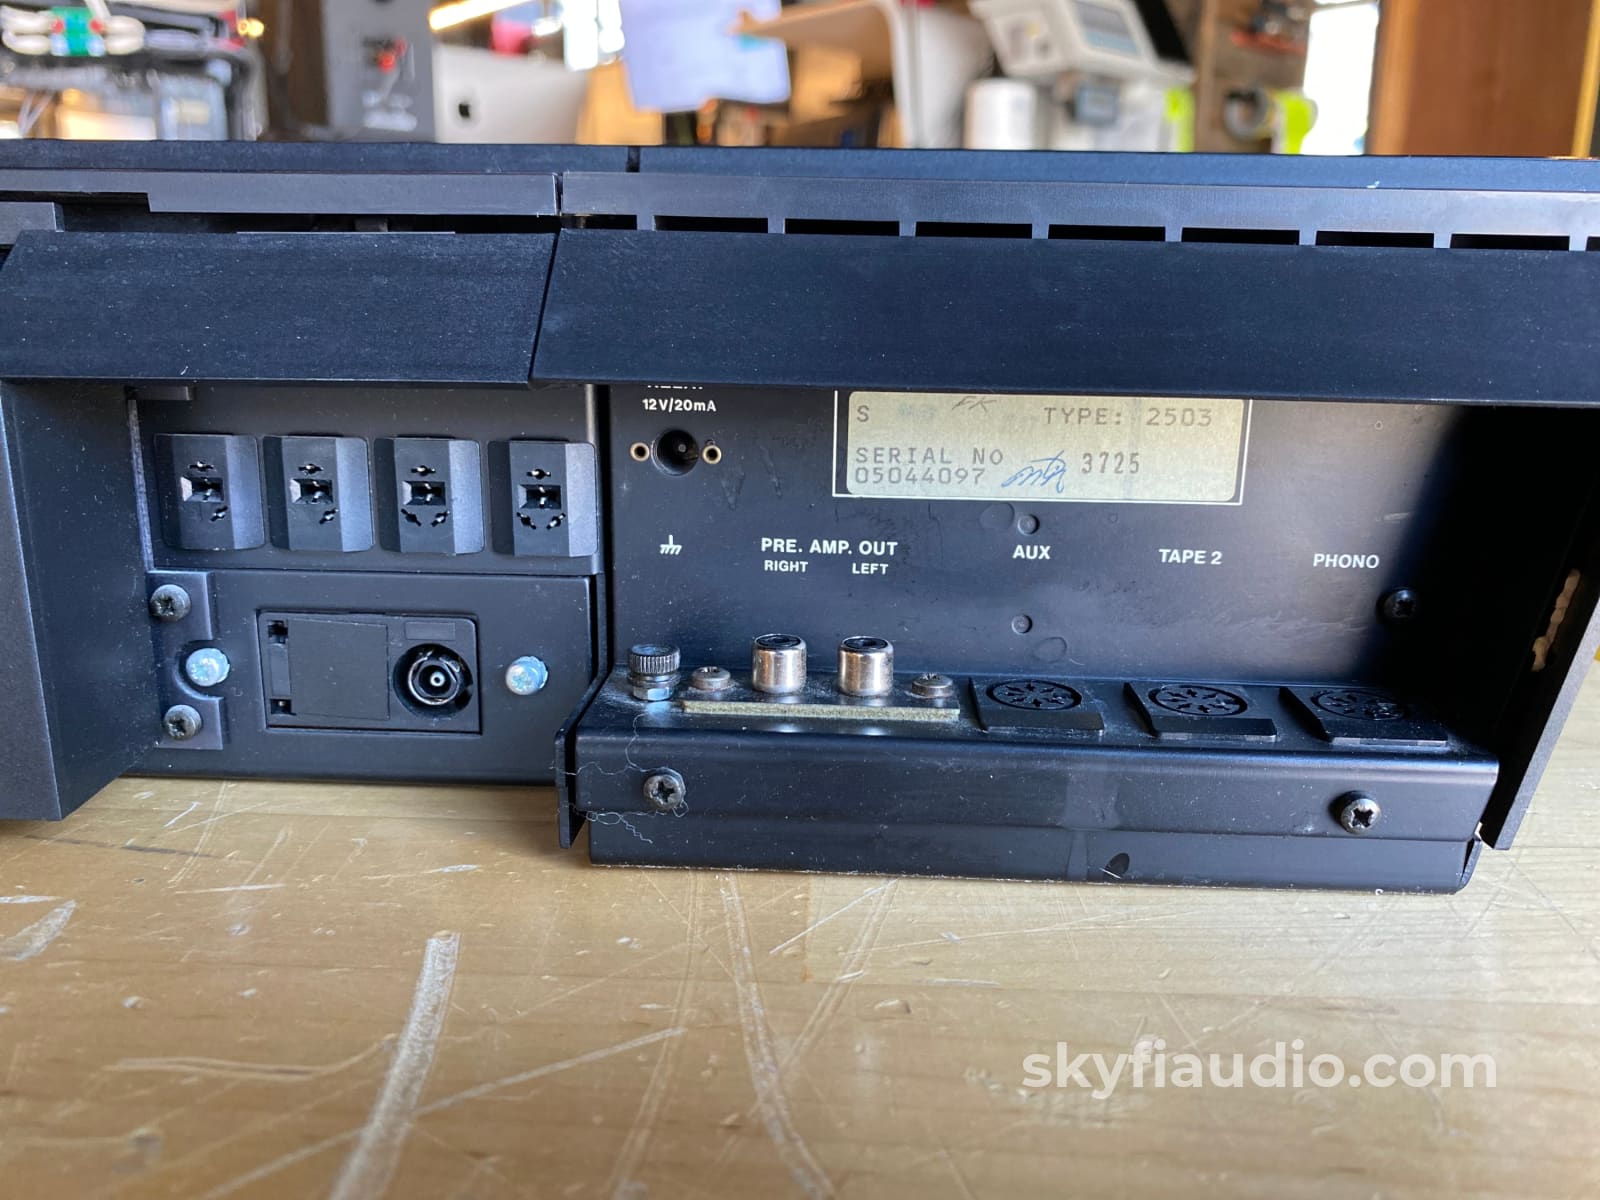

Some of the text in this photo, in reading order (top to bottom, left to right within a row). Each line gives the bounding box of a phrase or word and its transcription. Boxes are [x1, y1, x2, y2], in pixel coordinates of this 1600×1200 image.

[642, 397, 717, 413] 12V/20mA
[856, 404, 870, 423] S
[1044, 407, 1122, 425] TYPE:
[1146, 407, 1213, 427] 2503
[855, 447, 1004, 466] SERIAL NO
[1081, 452, 1140, 475] 3725
[855, 467, 986, 485] 05044097
[761, 537, 898, 556] PRE. AMP. OUT
[1012, 545, 1051, 560] AUX
[1158, 548, 1223, 565] TAPE 2
[1312, 553, 1380, 569] PHONO
[763, 560, 809, 573] RIGHT
[852, 563, 889, 575] LEFT
